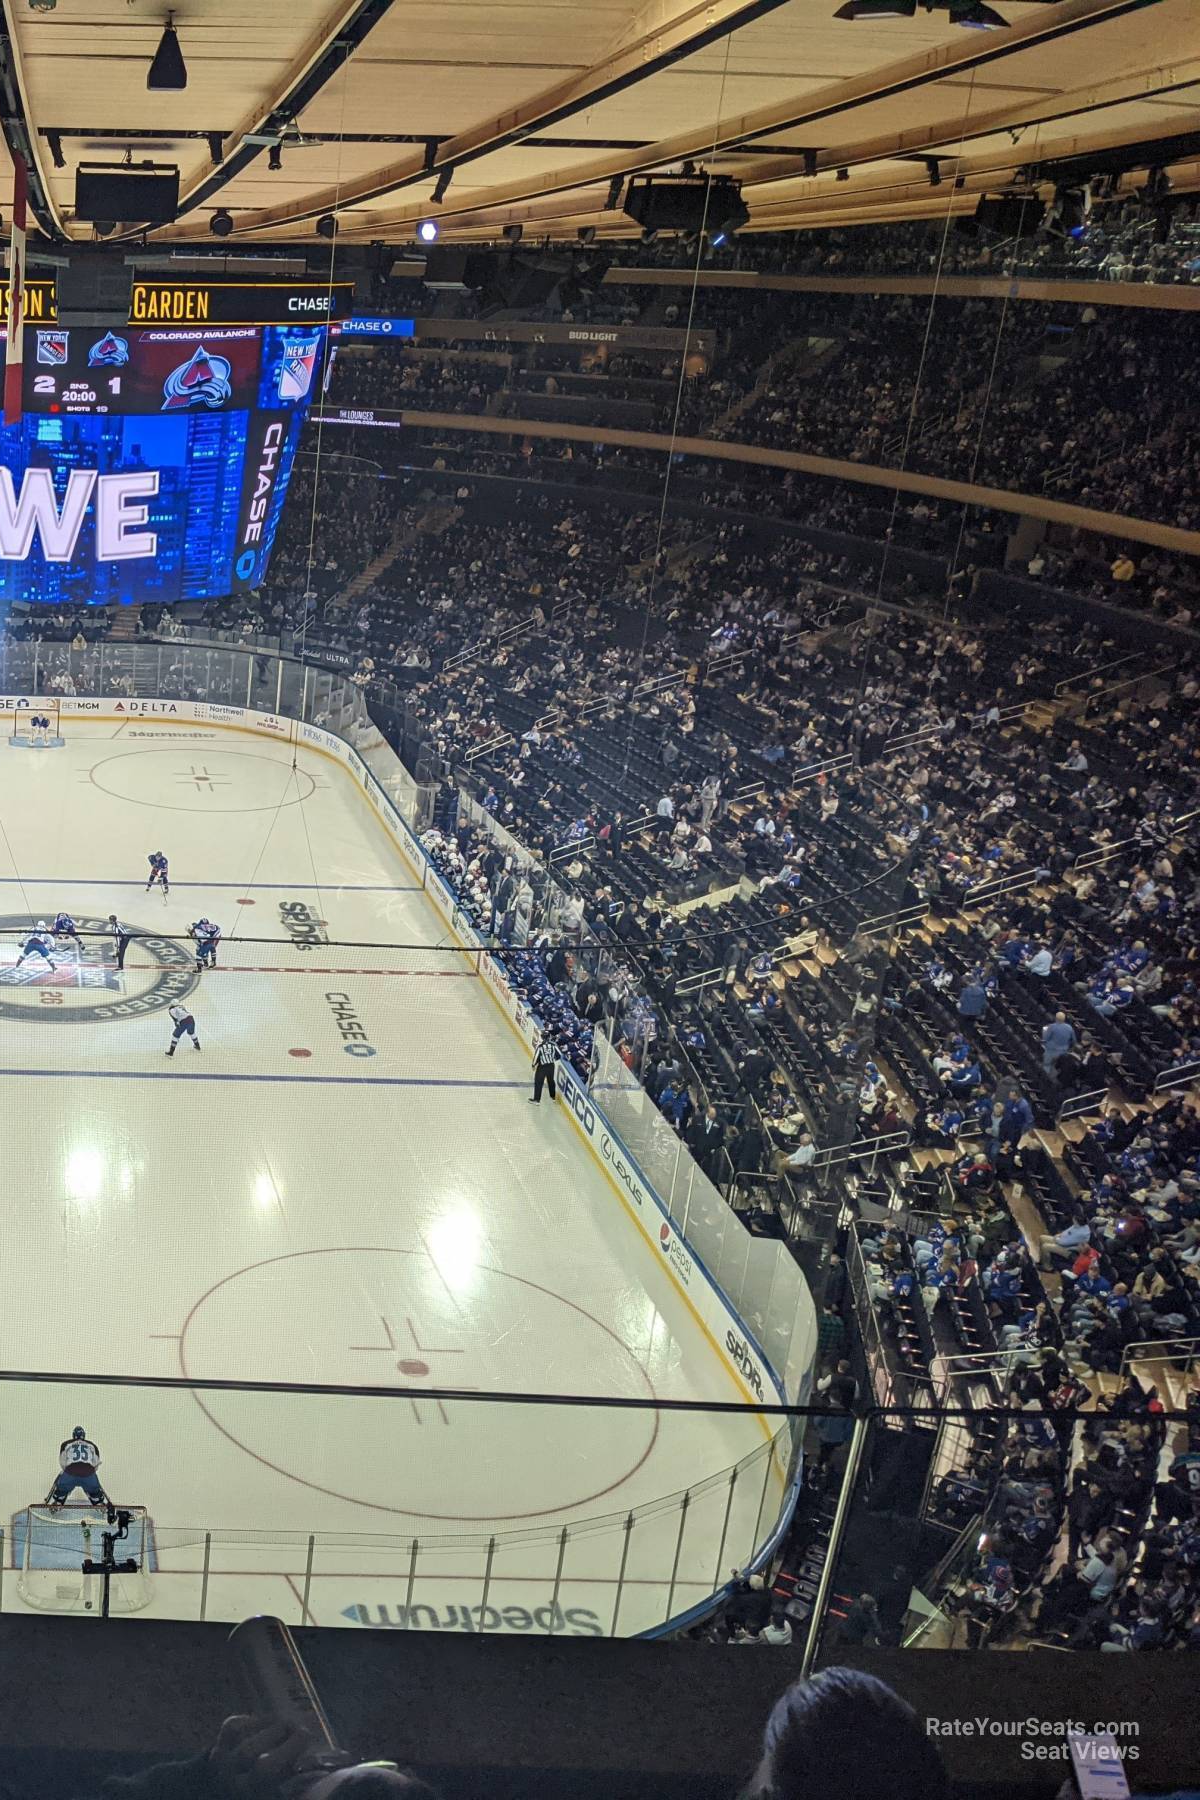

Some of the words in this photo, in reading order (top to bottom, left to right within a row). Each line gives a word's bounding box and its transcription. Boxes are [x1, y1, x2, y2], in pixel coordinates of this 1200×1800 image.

[134, 287, 209, 319] GARDEN
[288, 297, 329, 311] CHASE
[342, 321, 380, 331] CHASE
[149, 332, 202, 341] COLORADO
[203, 329, 256, 339] AVALANCHE
[569, 331, 589, 340] BUD
[590, 333, 618, 342] LIGHT
[33, 375, 56, 393] 2
[108, 377, 121, 394] 1
[61, 390, 97, 402] 20:00
[244, 423, 283, 543] CHASE
[326, 653, 350, 665] ULTRA
[61, 702, 99, 710] BETMGM
[129, 701, 178, 713] DELTA
[209, 704, 245, 717] Northwell
[94, 971, 190, 1018] RANGERS
[324, 991, 370, 1041] CHASE
[556, 1065, 595, 1136] GEICO
[610, 1151, 643, 1206] LEXUS
[671, 1239, 692, 1277] pepsi
[71, 1444, 90, 1462] 35
[356, 1599, 605, 1637] Spectrum
